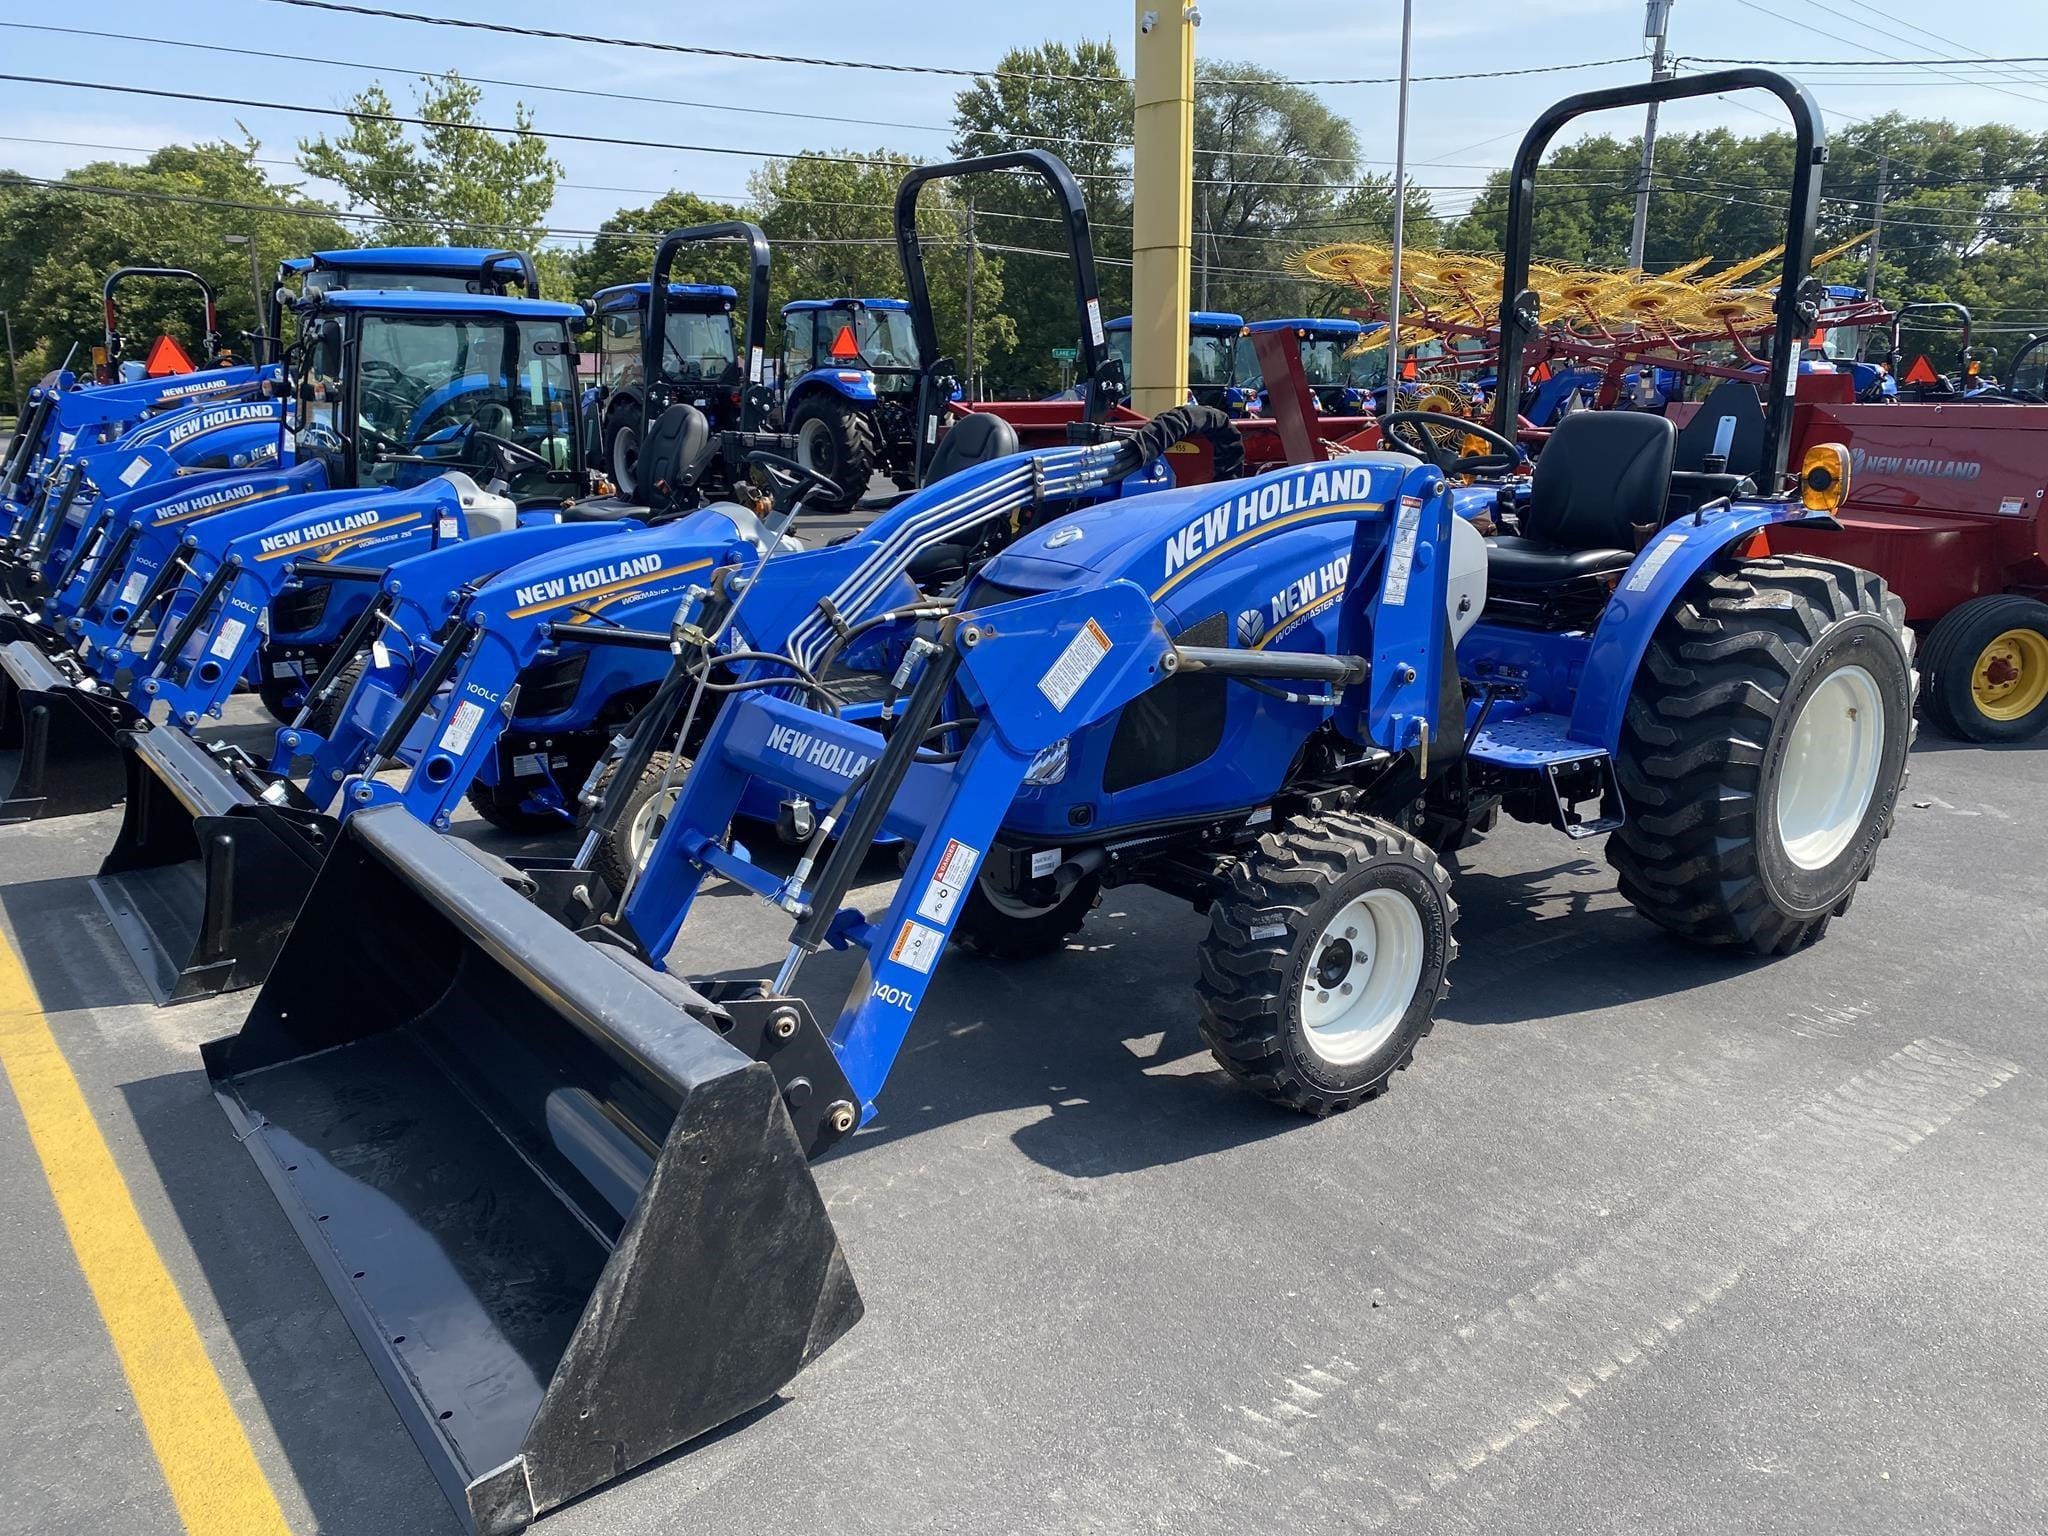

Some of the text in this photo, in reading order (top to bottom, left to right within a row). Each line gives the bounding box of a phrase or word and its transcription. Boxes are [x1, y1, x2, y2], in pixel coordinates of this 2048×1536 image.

[161, 379, 227, 398] NEW HOLLAND
[169, 404, 273, 444] NEW HOLLAND
[1866, 455, 1981, 481] NEW HOLLAND
[155, 484, 254, 520] NEW HOLLAND
[260, 510, 380, 553] NEW HOLLAND
[1164, 467, 1372, 578] NEW HOLLAND
[135, 556, 159, 569] 100LC
[514, 553, 663, 607] NEW HOLLAND
[231, 596, 258, 615] 100LC
[1271, 571, 1317, 624] NEW
[1275, 598, 1335, 644] WORKMASTER
[466, 681, 500, 703] 100LC
[765, 723, 877, 780] NEW HOLLA
[871, 980, 914, 1012] 140TL
